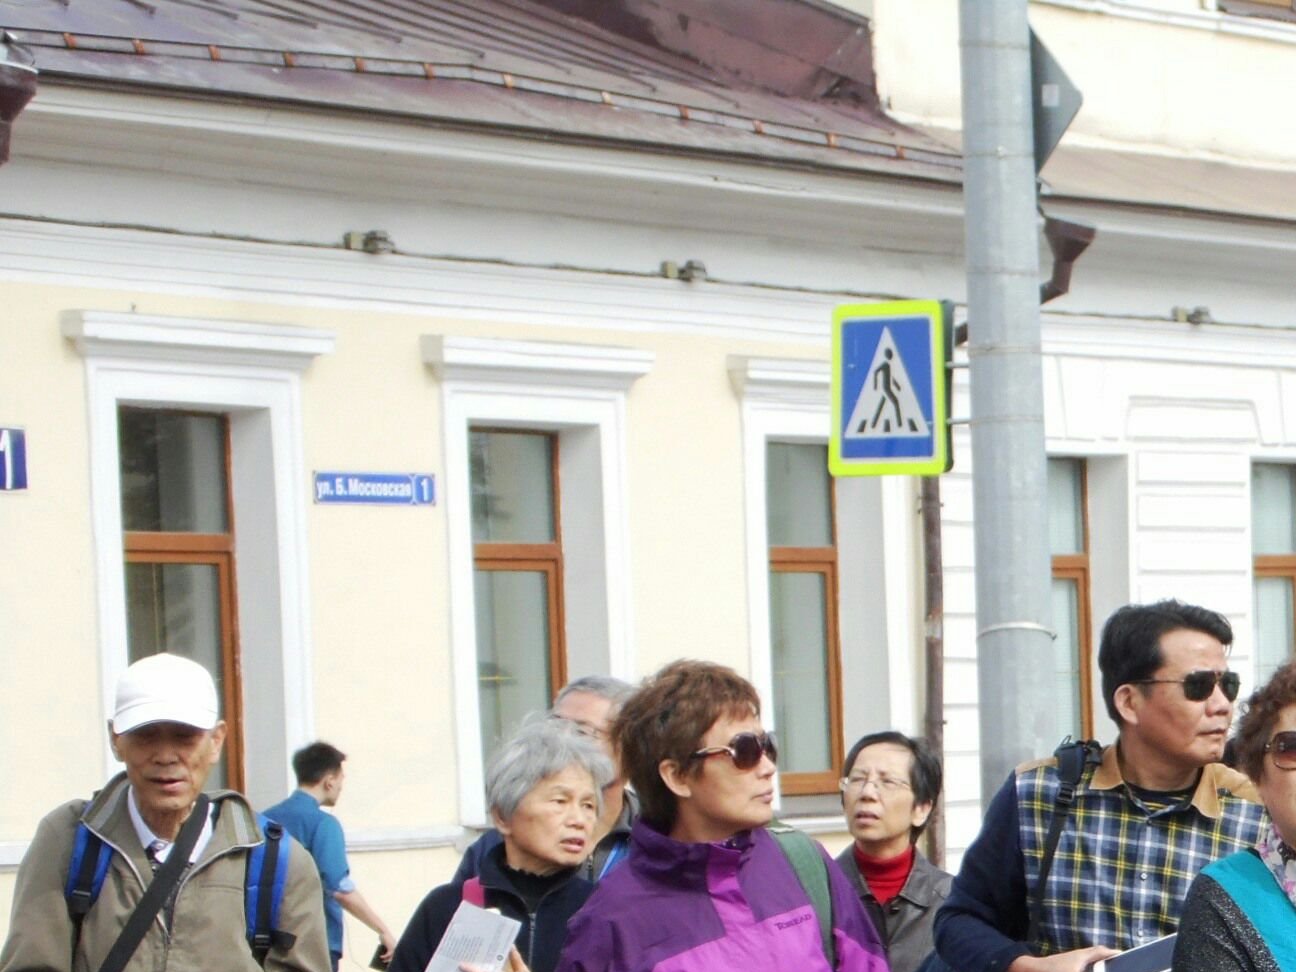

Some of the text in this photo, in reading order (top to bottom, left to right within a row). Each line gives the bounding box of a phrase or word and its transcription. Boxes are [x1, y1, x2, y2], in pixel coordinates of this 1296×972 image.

[316, 477, 430, 501] ул. Б. Московская 1
